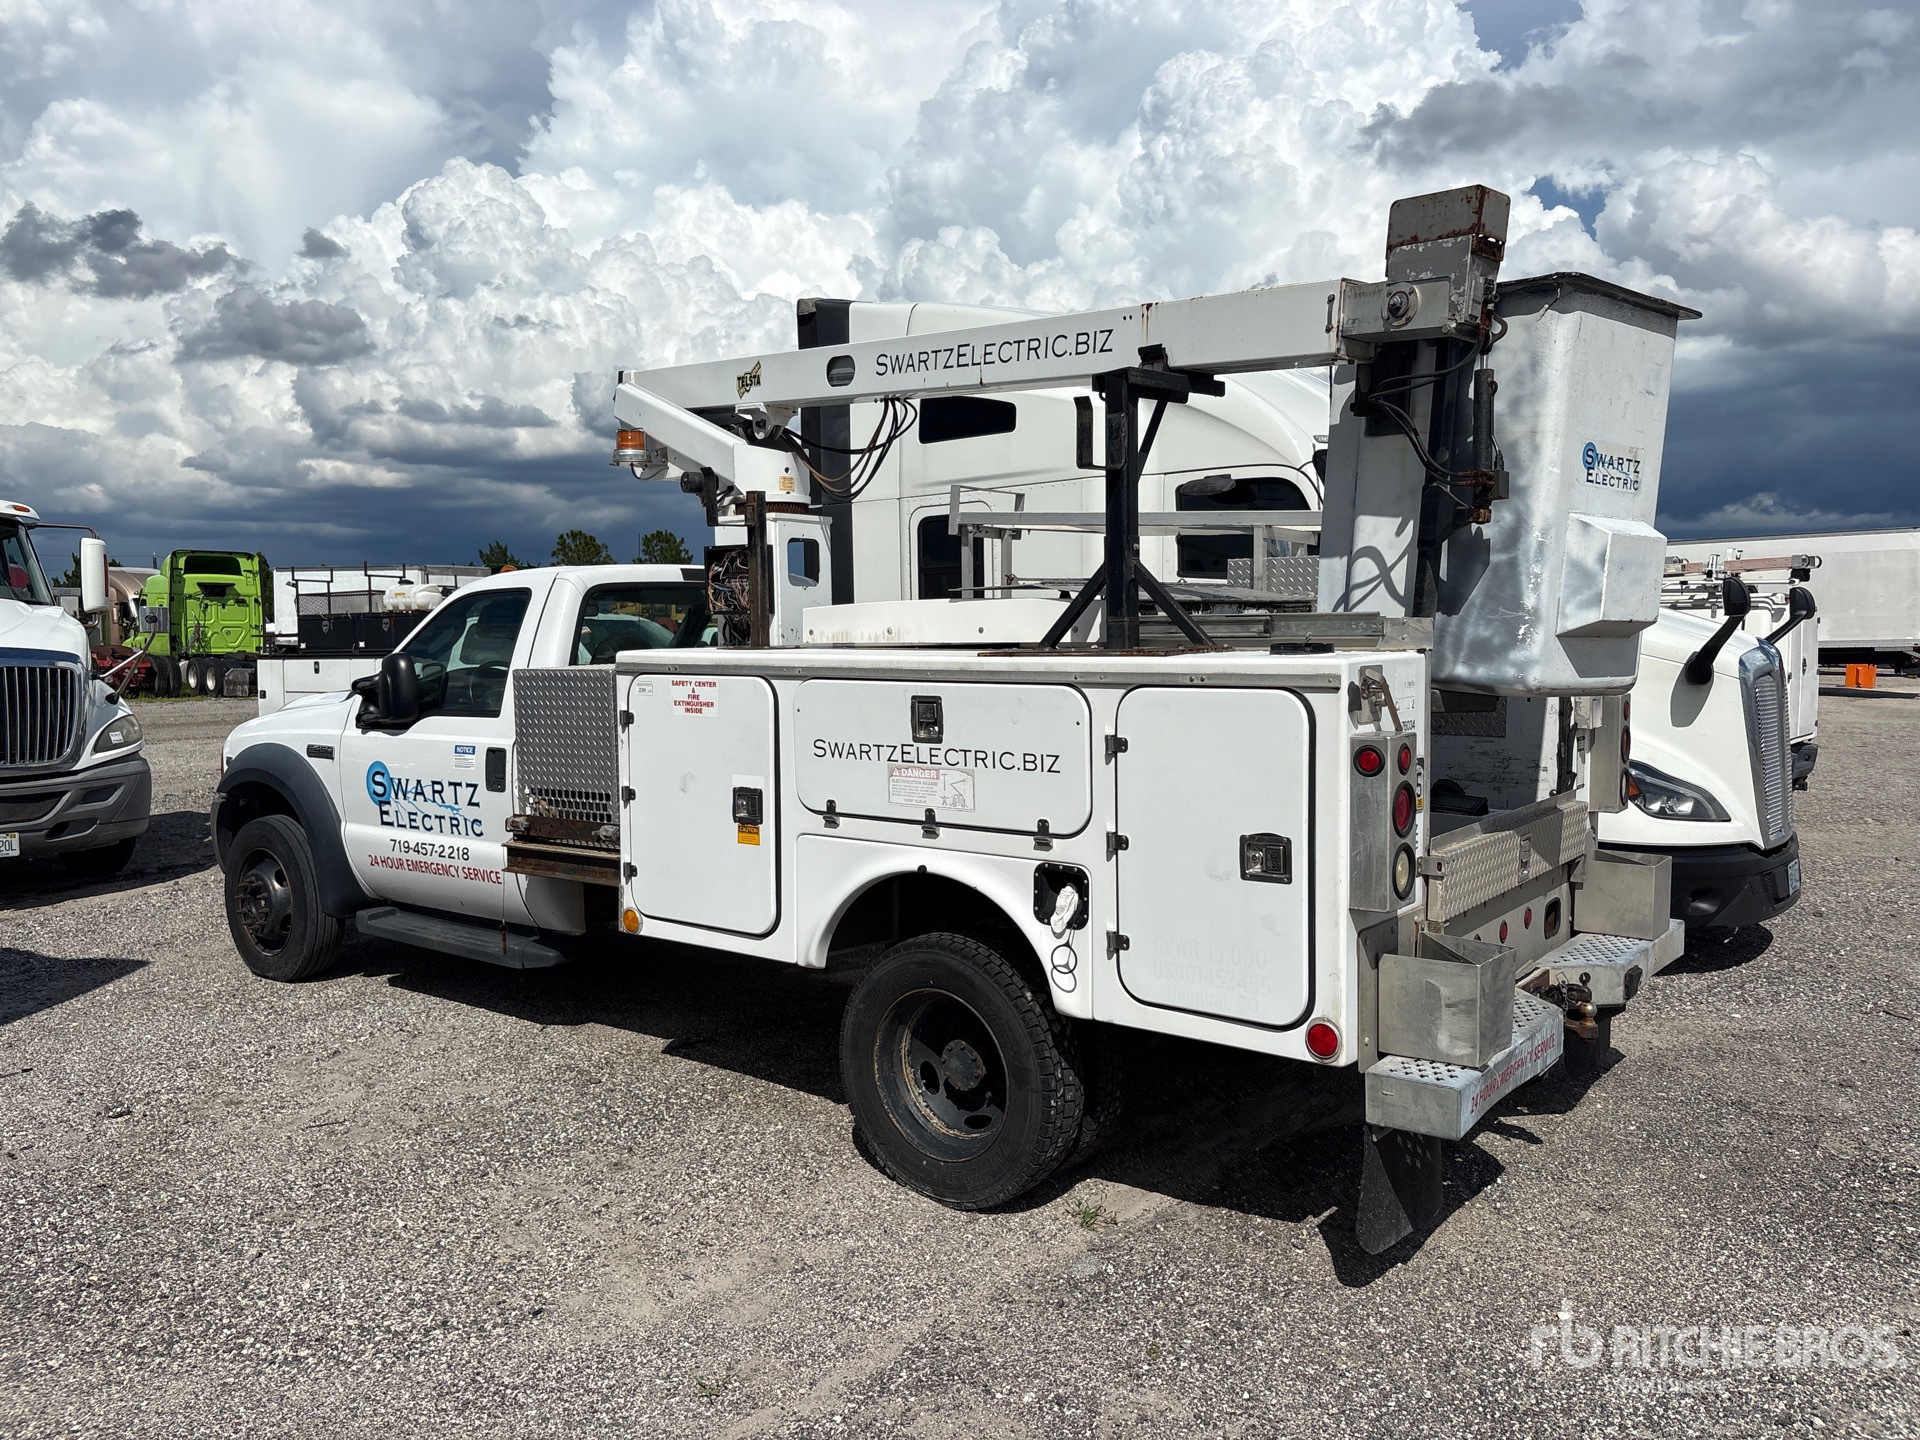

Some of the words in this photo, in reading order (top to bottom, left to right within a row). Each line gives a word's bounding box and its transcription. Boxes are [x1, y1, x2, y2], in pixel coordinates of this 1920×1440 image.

[1585, 448, 1641, 474] SWARTZ
[1586, 466, 1639, 491] ELECTRIC
[673, 700, 715, 708] EXTINGUISHER
[456, 746, 474, 754] NOTICE
[901, 768, 937, 779] DANGER
[371, 770, 480, 808] SWARTZ
[378, 800, 484, 837] ELECTRIC
[390, 839, 470, 861] 719-457-2218
[368, 854, 380, 867] 24
[380, 855, 406, 871] HOUR
[406, 859, 460, 879] EMERGENCY
[461, 866, 503, 885] SERVICE
